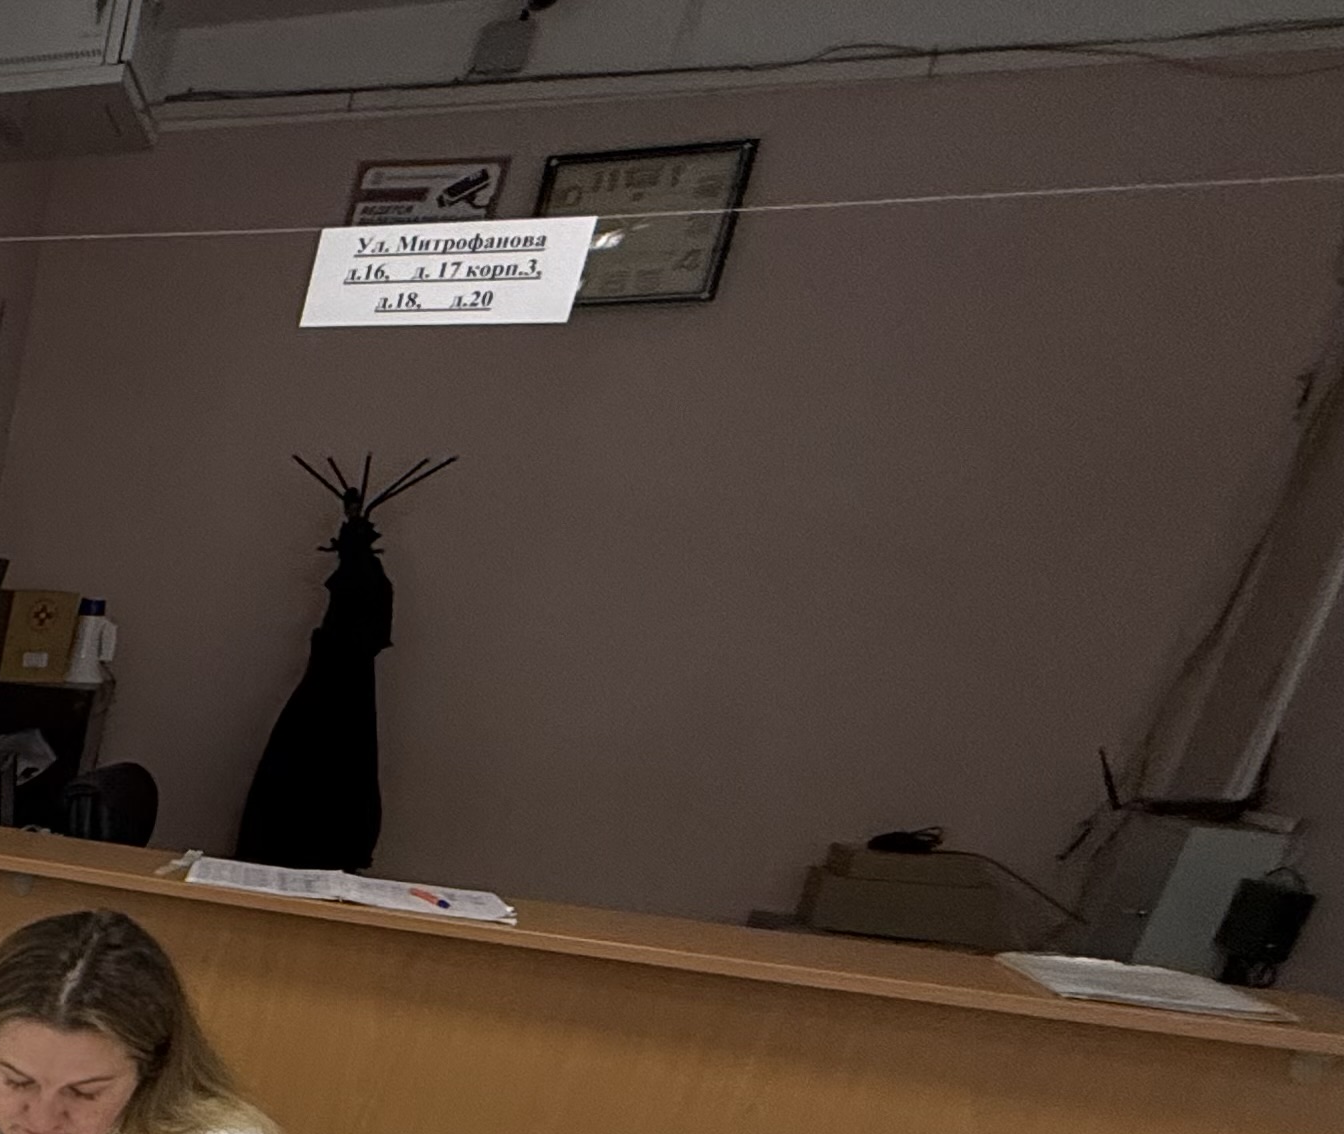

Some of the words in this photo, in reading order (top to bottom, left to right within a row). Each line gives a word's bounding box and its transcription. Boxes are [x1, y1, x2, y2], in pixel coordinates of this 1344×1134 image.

[357, 237, 390, 254] Ул.
[397, 233, 547, 252] Митрофанова
[345, 263, 391, 282] д.16,
[437, 261, 460, 279] 17
[466, 258, 543, 280] корп.3,
[376, 291, 422, 310] д.18,
[449, 290, 494, 308] д.20
